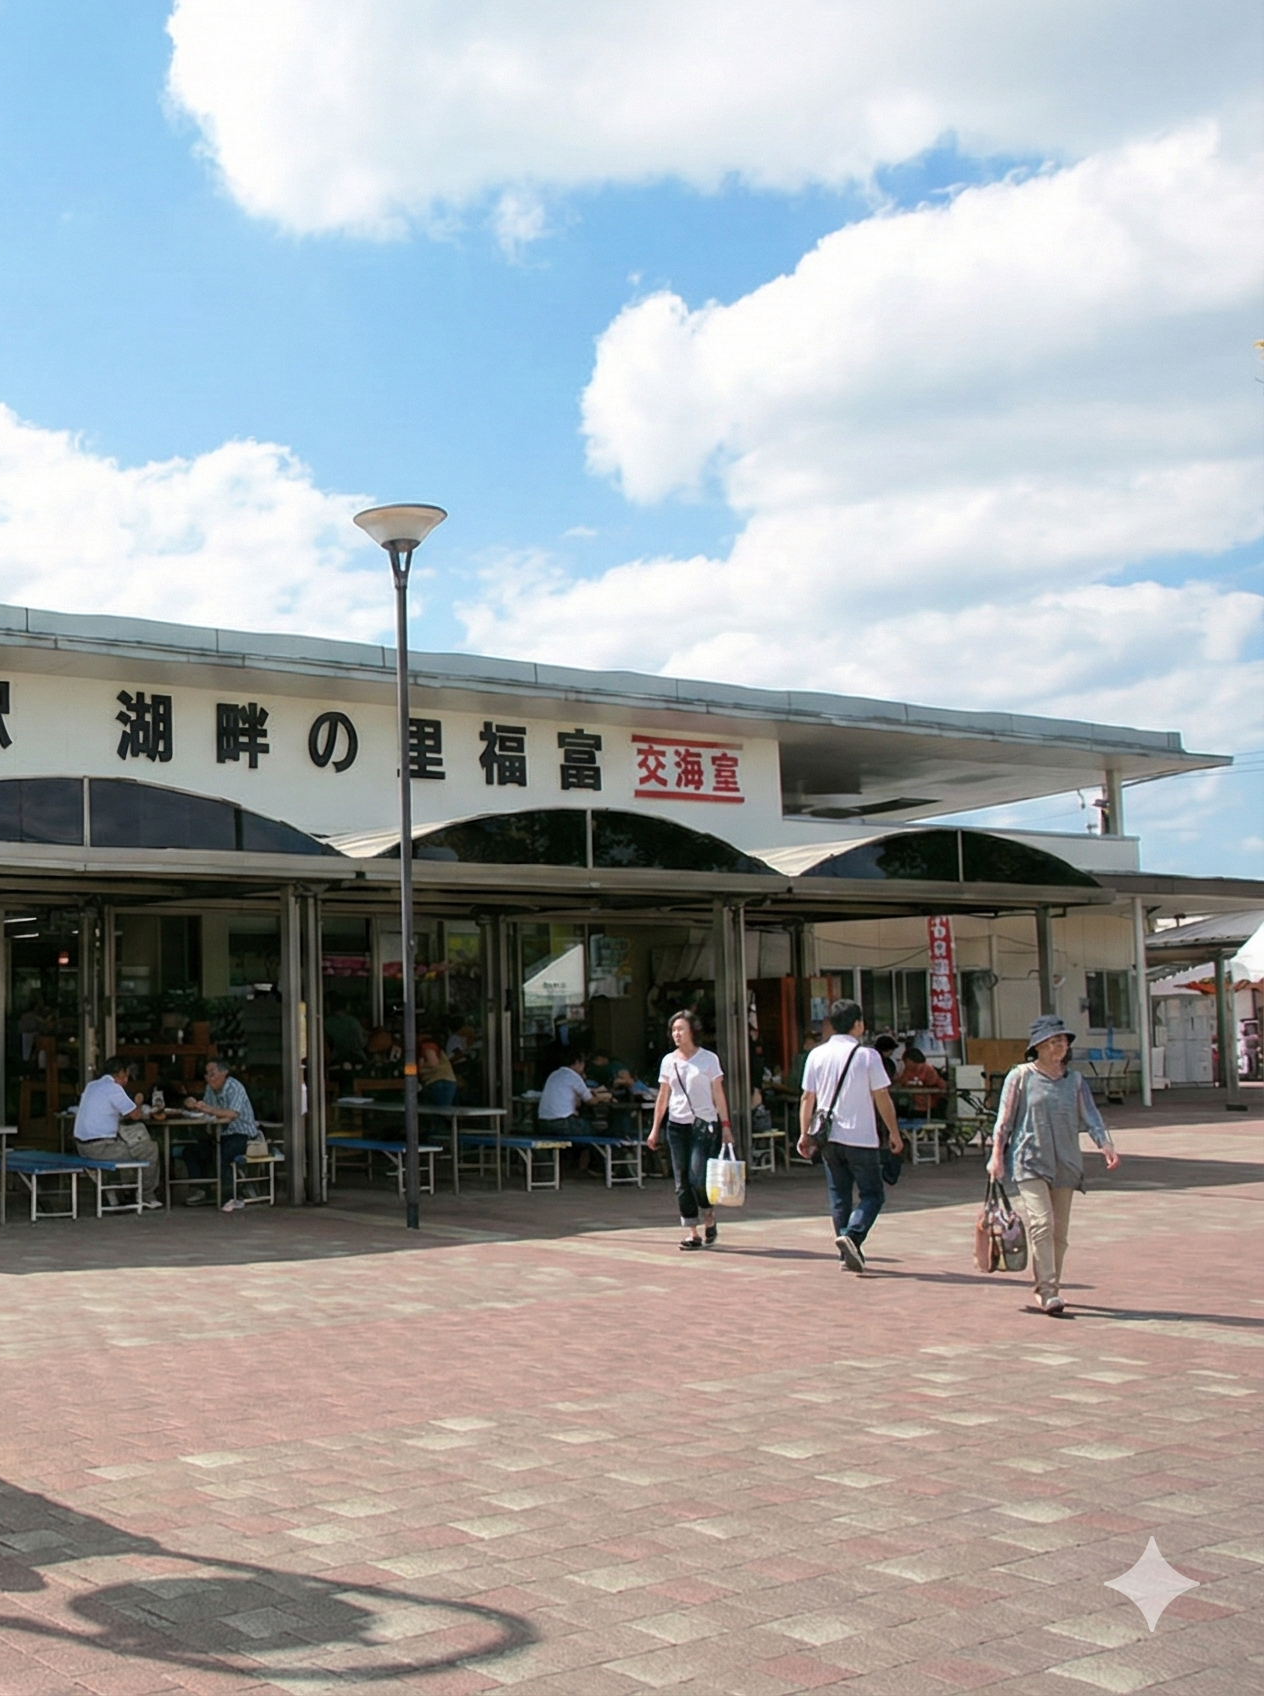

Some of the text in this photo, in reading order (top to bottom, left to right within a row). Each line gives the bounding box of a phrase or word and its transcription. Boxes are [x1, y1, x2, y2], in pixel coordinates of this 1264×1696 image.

[115, 689, 602, 791] 湖畔の里福富
